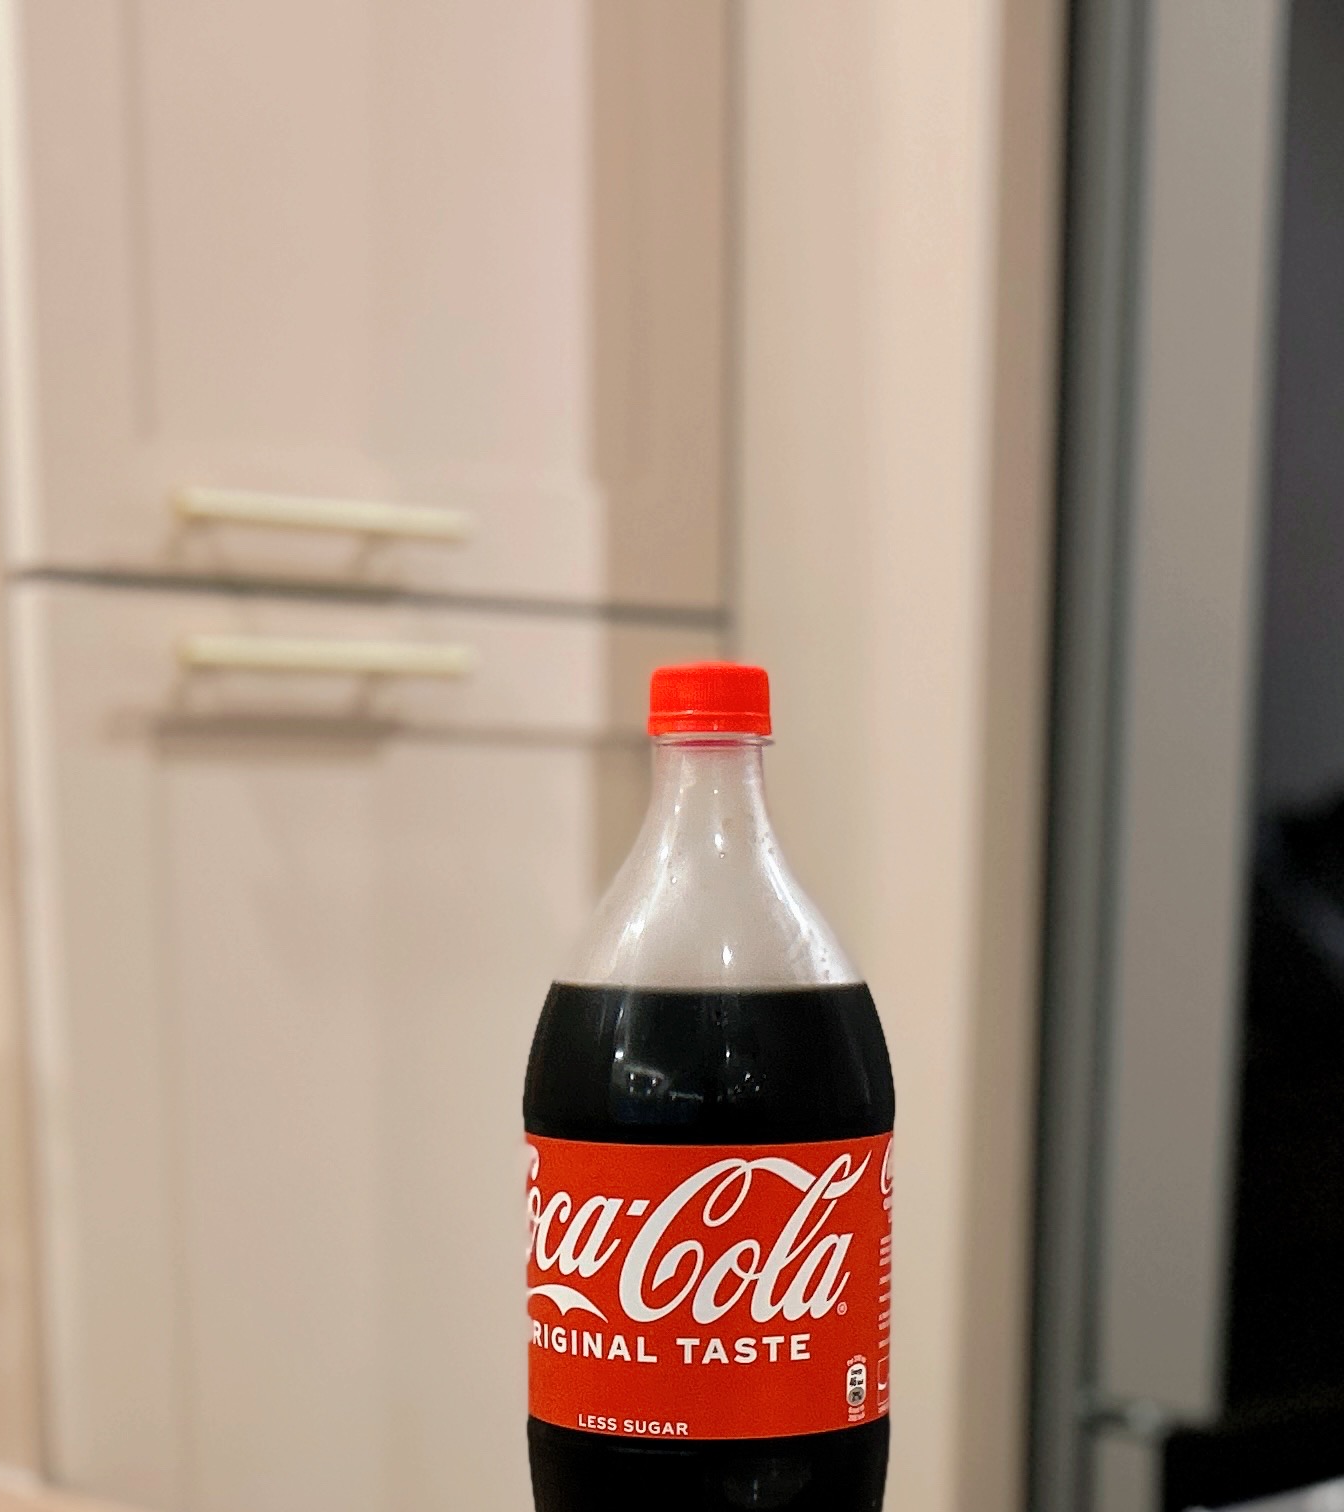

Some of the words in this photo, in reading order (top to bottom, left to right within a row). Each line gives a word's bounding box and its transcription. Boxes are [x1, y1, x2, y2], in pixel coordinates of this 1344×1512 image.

[530, 1319, 658, 1363] RIGINAL
[675, 1333, 811, 1365] TASTE
[578, 1413, 617, 1431] LESS
[623, 1419, 689, 1436] SUGAR
